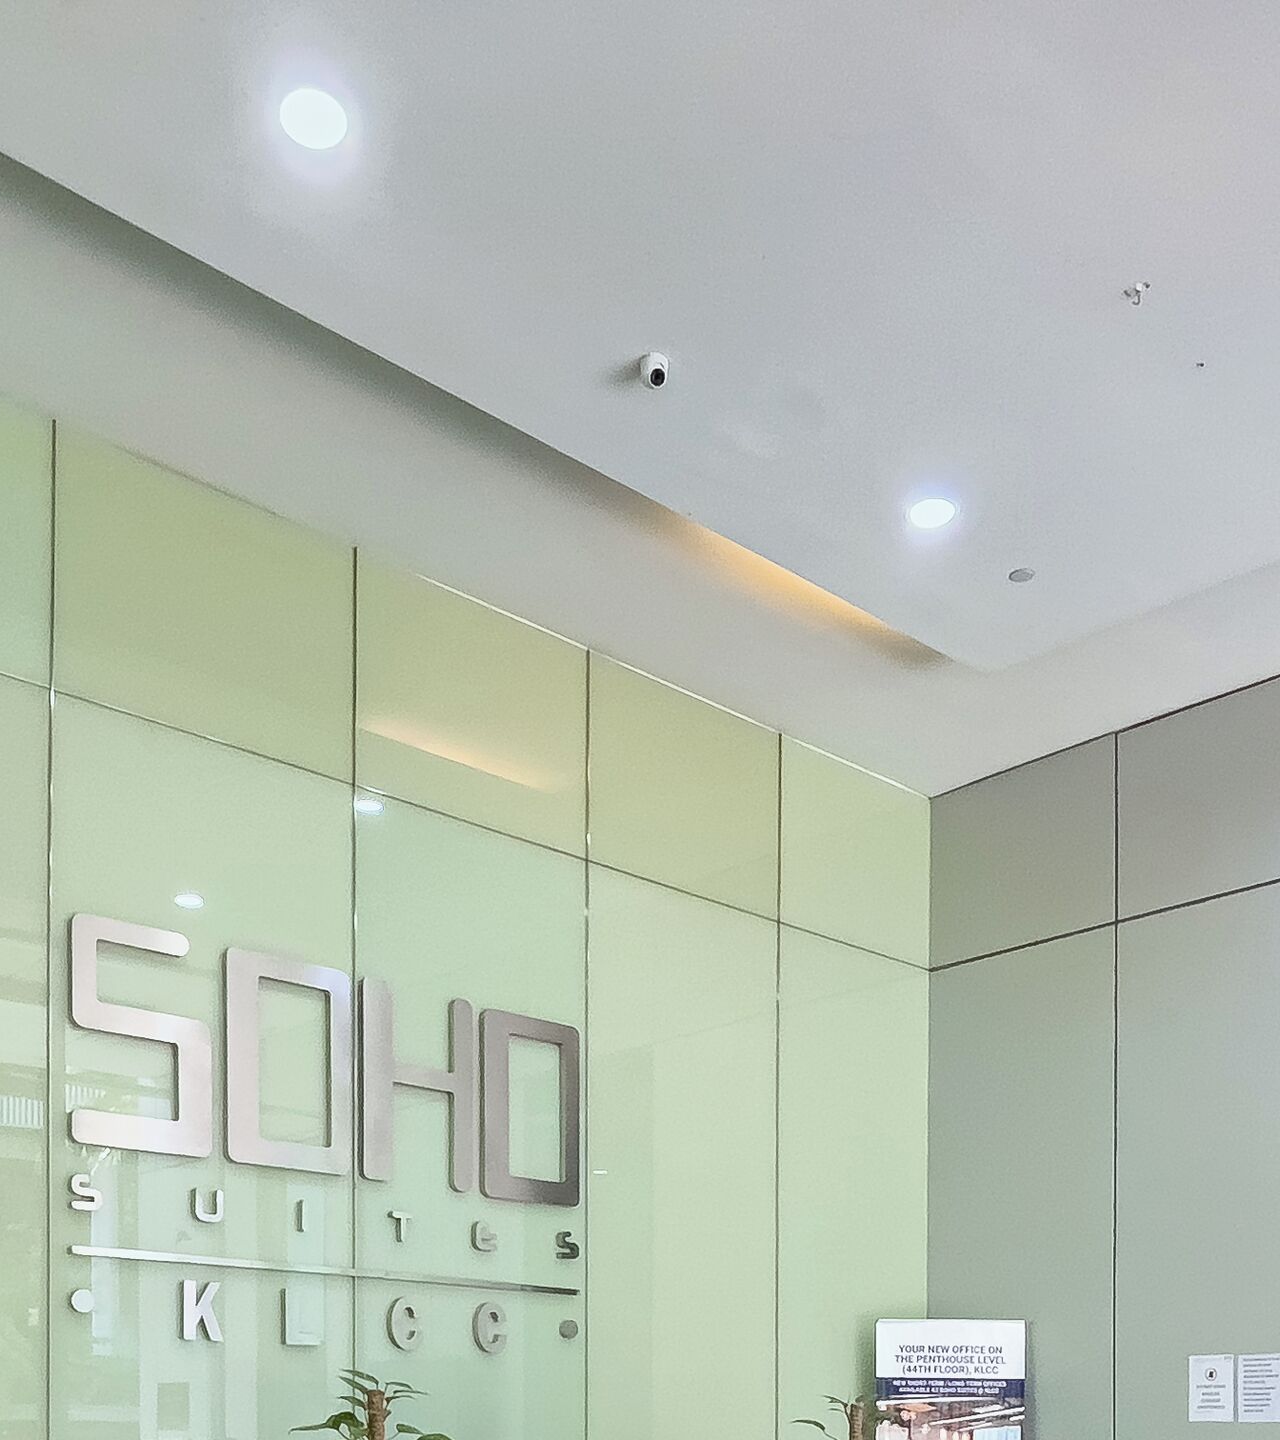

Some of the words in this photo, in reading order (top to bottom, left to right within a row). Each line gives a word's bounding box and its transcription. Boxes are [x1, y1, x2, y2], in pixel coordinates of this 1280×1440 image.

[69, 912, 581, 1208] SOHO
[179, 1279, 509, 1355] KLCC
[899, 1345, 925, 1354] YOUR
[928, 1345, 950, 1354] NEW
[952, 1345, 986, 1354] OFFICE
[988, 1346, 1003, 1354] ON
[895, 1355, 914, 1363] THE
[916, 1355, 975, 1364] PENTHOUSE
[977, 1356, 1007, 1364] LEVEL
[902, 1365, 931, 1375] (44TH
[974, 1366, 999, 1374] KLCC
